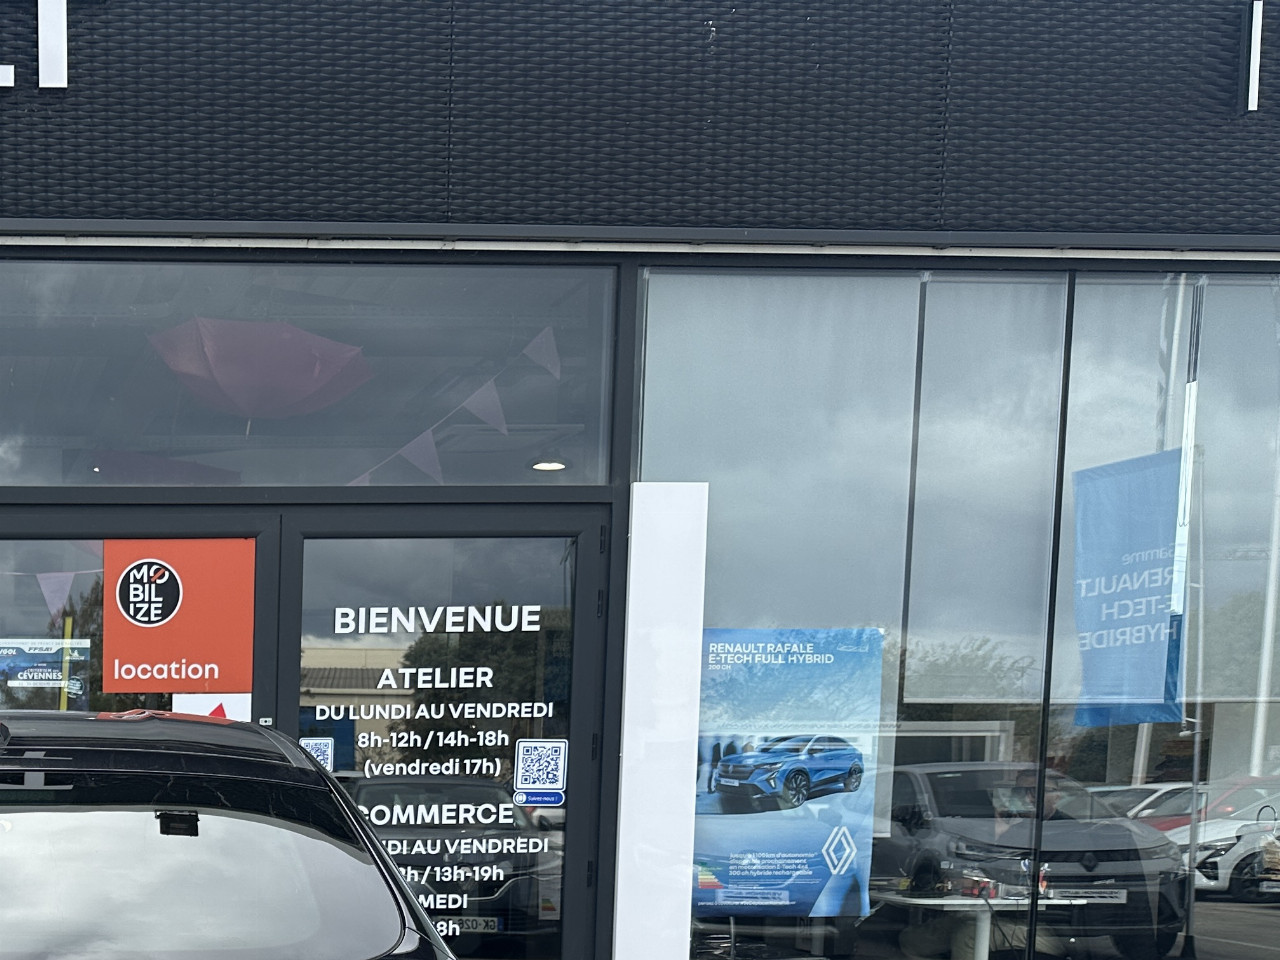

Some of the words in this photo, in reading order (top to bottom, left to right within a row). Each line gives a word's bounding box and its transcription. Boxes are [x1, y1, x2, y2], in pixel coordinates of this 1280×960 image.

[334, 605, 541, 633] BIENVENUE
[709, 643, 764, 653] RENAULT
[767, 643, 814, 653] RAFALE
[708, 654, 752, 664] E-TECH
[754, 654, 785, 664] FULL
[788, 654, 834, 664] HYBRID
[114, 658, 219, 680] location
[376, 667, 493, 689] ATELIER
[315, 705, 344, 720] DU
[349, 704, 411, 720] LUNDI
[415, 703, 445, 719] AU
[449, 702, 553, 718] VENDREDI
[357, 732, 422, 748] 8h-12h
[437, 730, 509, 747] 14h-18h
[364, 759, 459, 778] (vendredi
[463, 758, 501, 776] 17h)
[411, 839, 441, 854] AU
[444, 838, 548, 854] VENDREDI
[433, 864, 504, 882] 13h-19h
